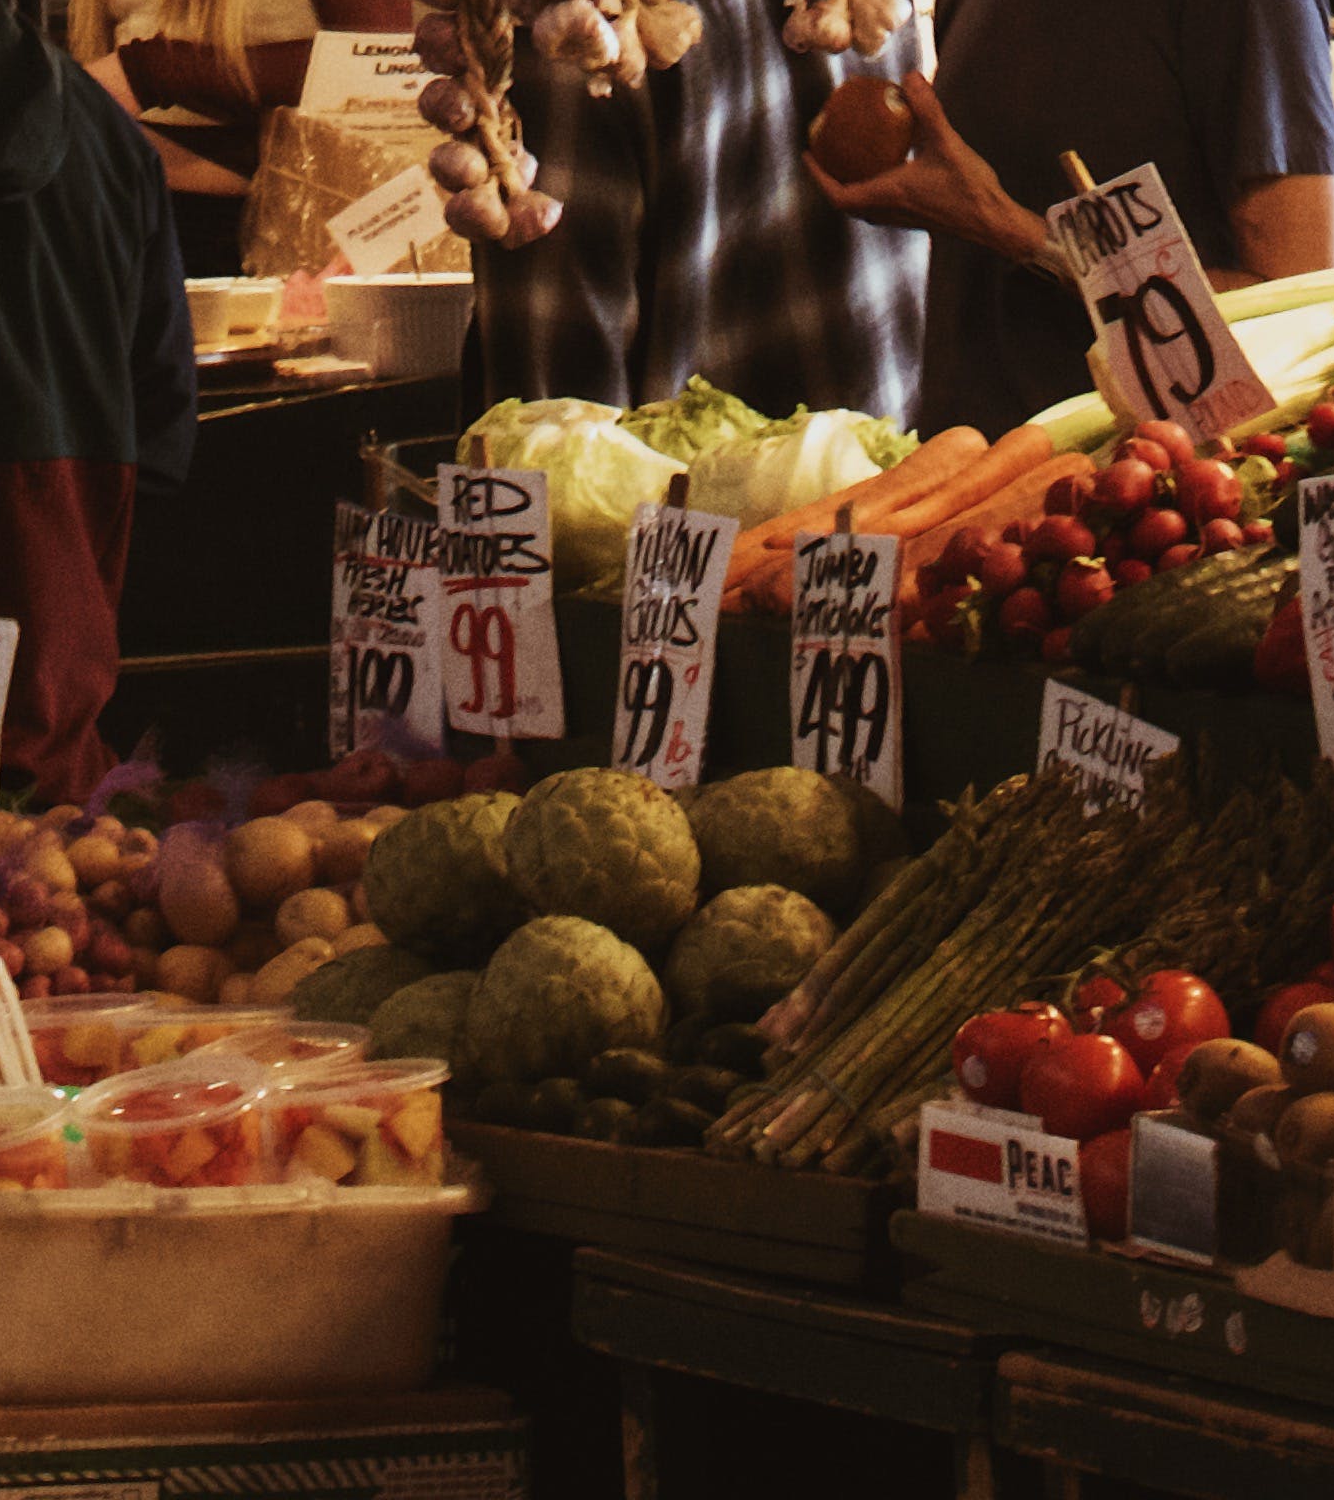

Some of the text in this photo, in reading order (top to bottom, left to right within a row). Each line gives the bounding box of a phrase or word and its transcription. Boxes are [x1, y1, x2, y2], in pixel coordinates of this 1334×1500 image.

[450, 475, 533, 523] RED
[799, 536, 879, 592] JUMBO
[451, 603, 515, 718] 99
